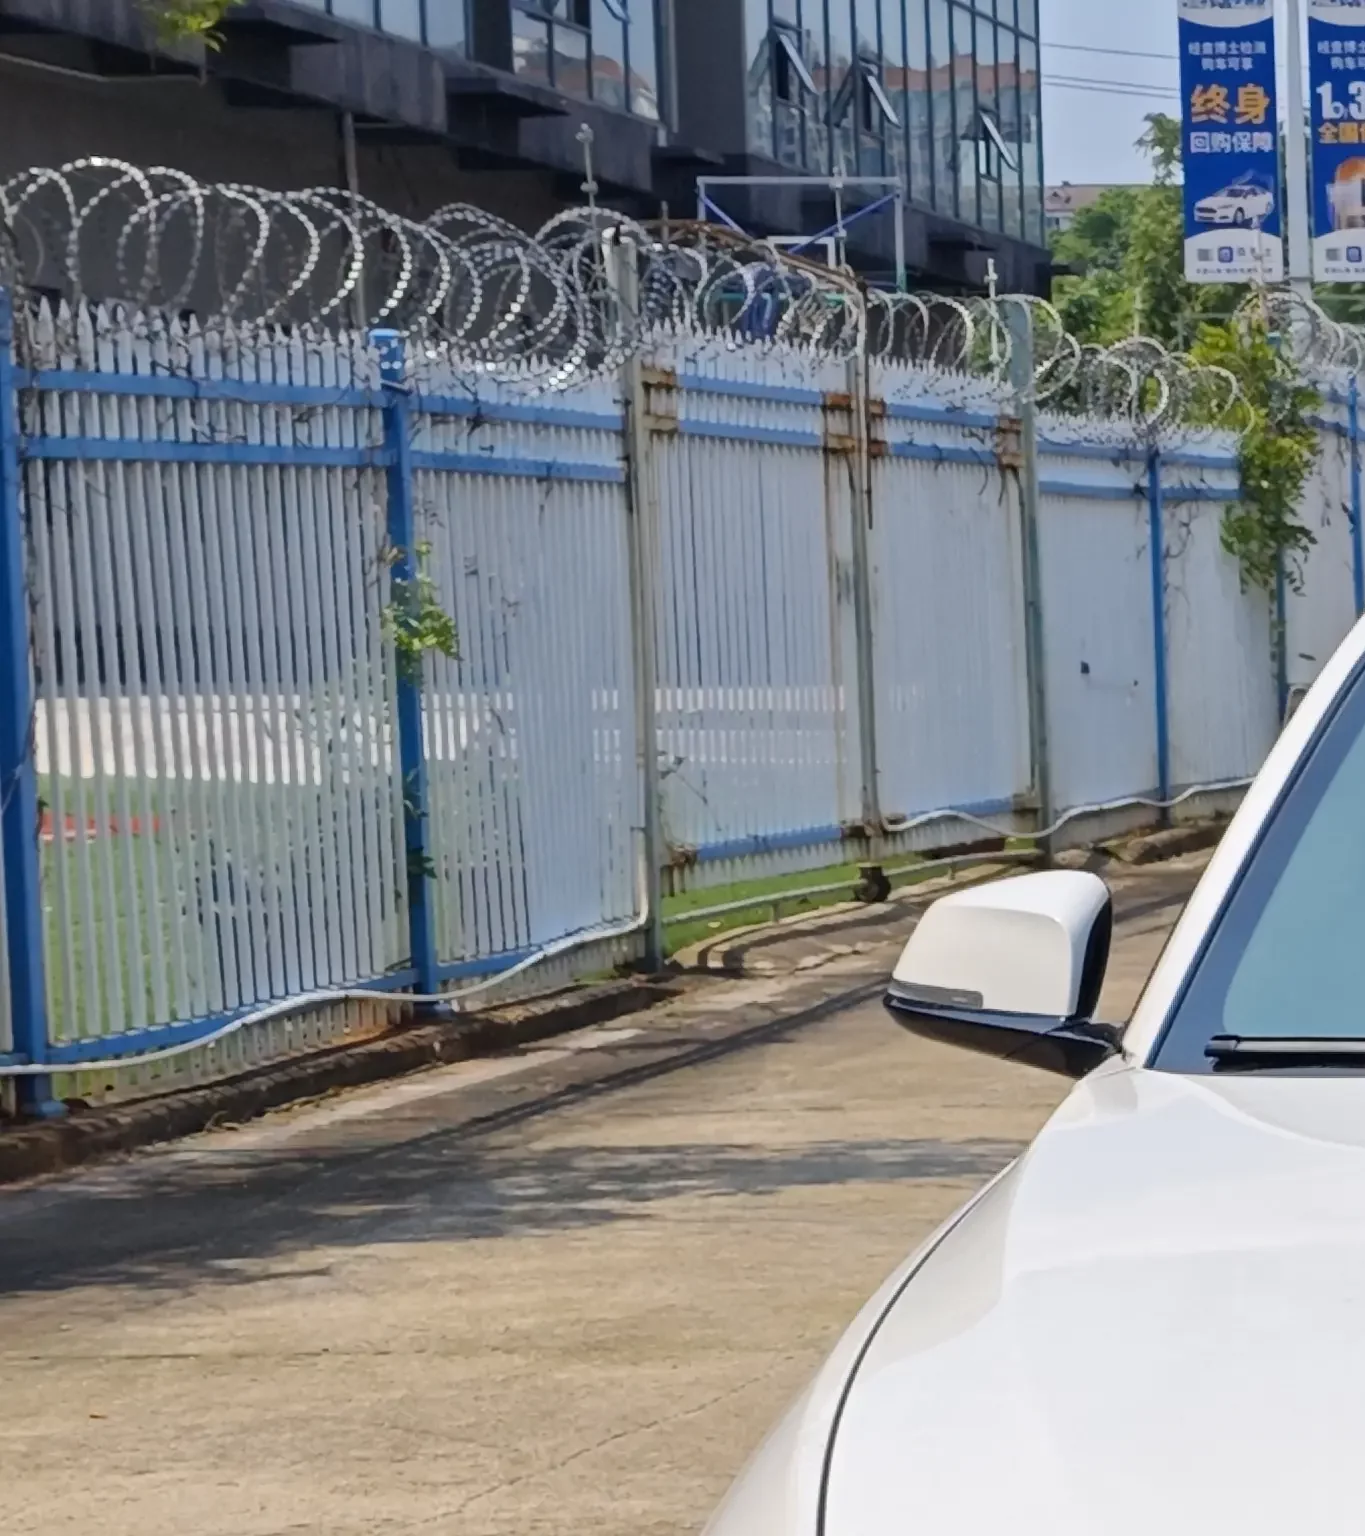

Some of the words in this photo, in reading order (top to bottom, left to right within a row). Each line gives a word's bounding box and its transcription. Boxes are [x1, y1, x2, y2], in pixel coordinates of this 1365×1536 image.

[1190, 83, 1270, 124] 终身
[1190, 131, 1273, 153] 回购保障
